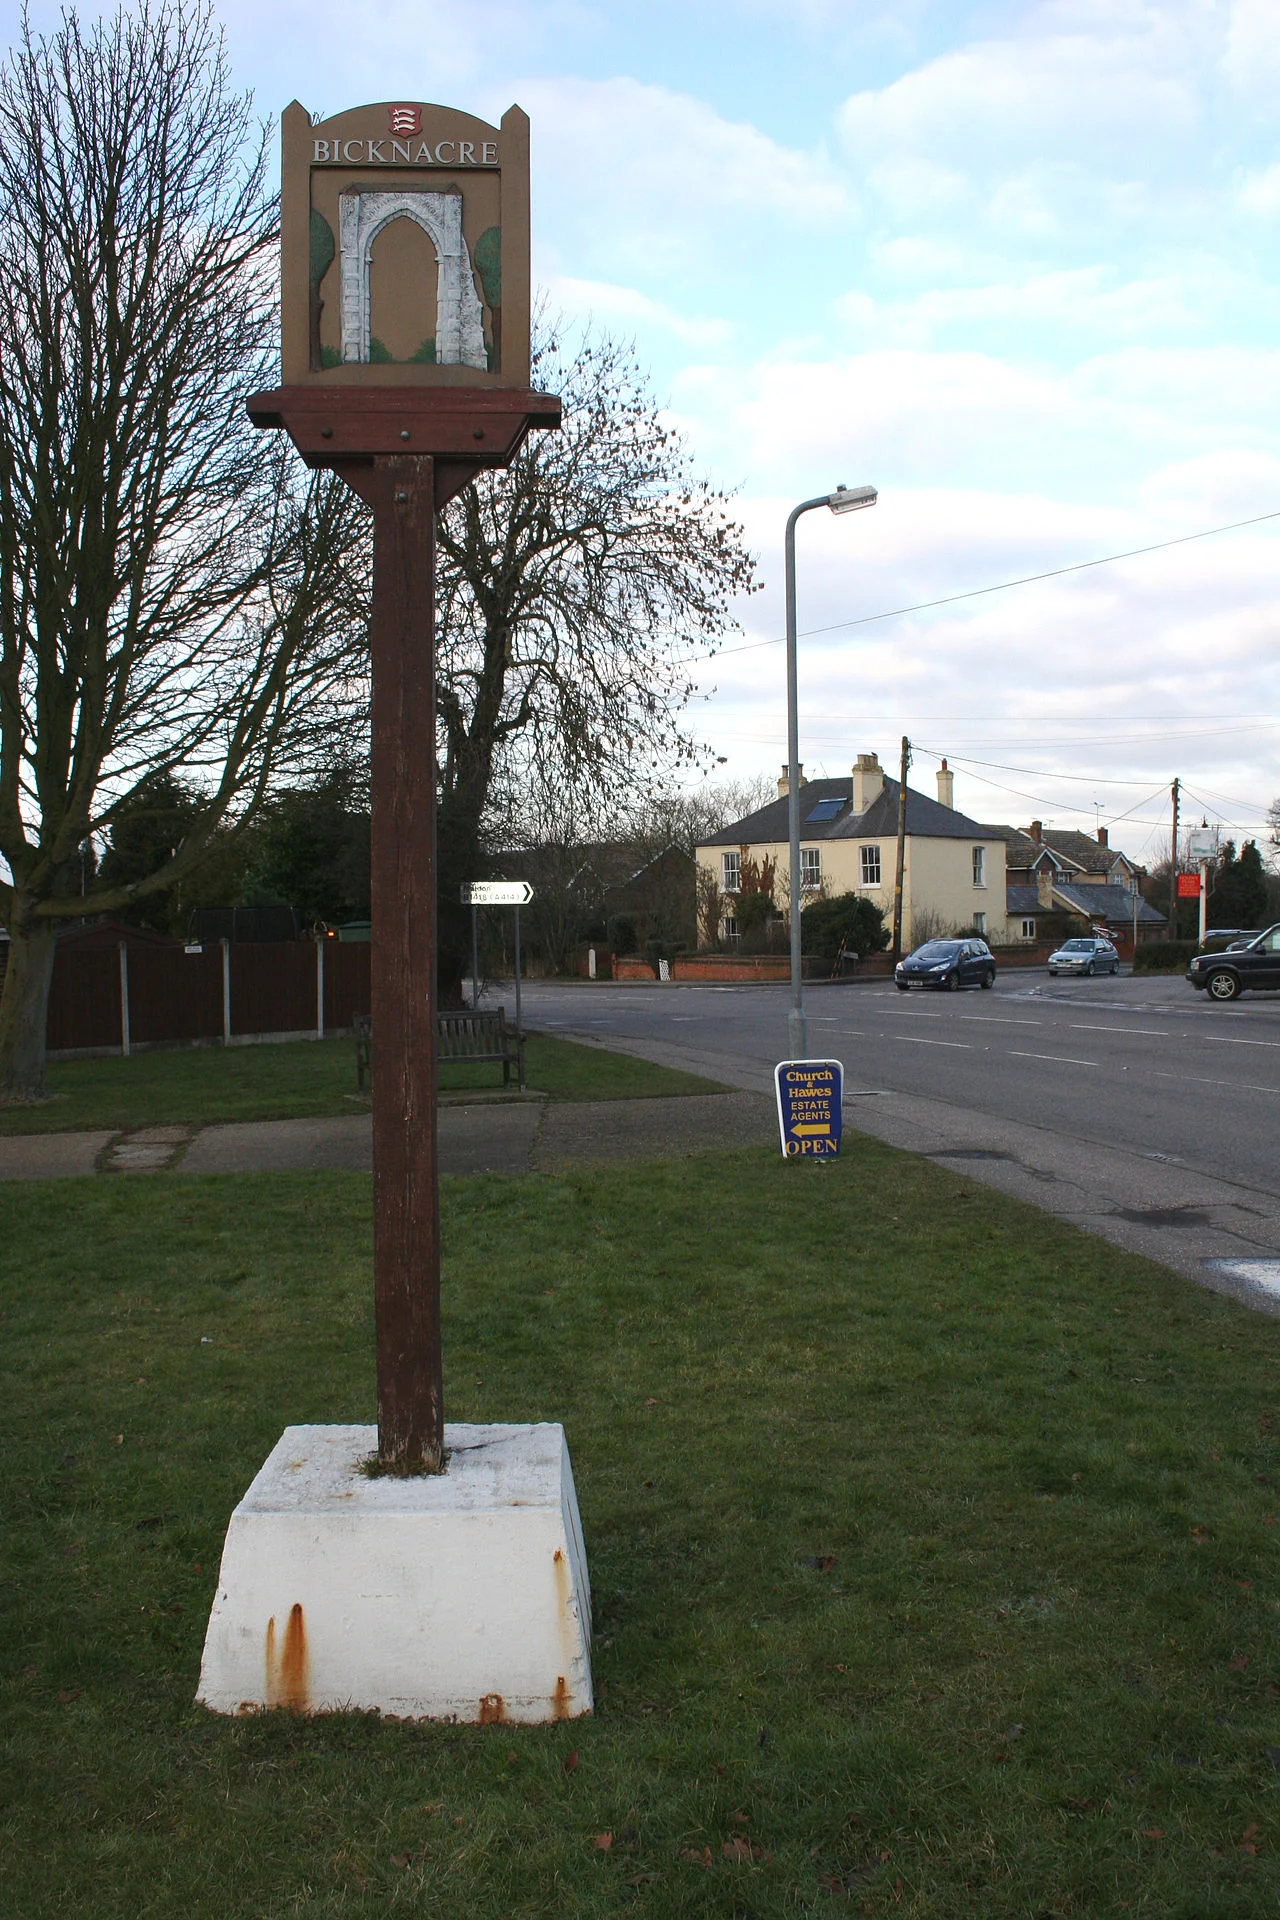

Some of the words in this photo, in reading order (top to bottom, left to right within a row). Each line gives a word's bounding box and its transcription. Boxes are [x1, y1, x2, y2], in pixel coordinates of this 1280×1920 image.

[312, 139, 499, 165] BICKNACRE
[786, 1070, 833, 1082] Church
[789, 1087, 832, 1098] Hawes
[791, 1100, 829, 1110] ESTATE
[790, 1111, 831, 1121] AGENTS
[785, 1138, 838, 1155] OPEN
